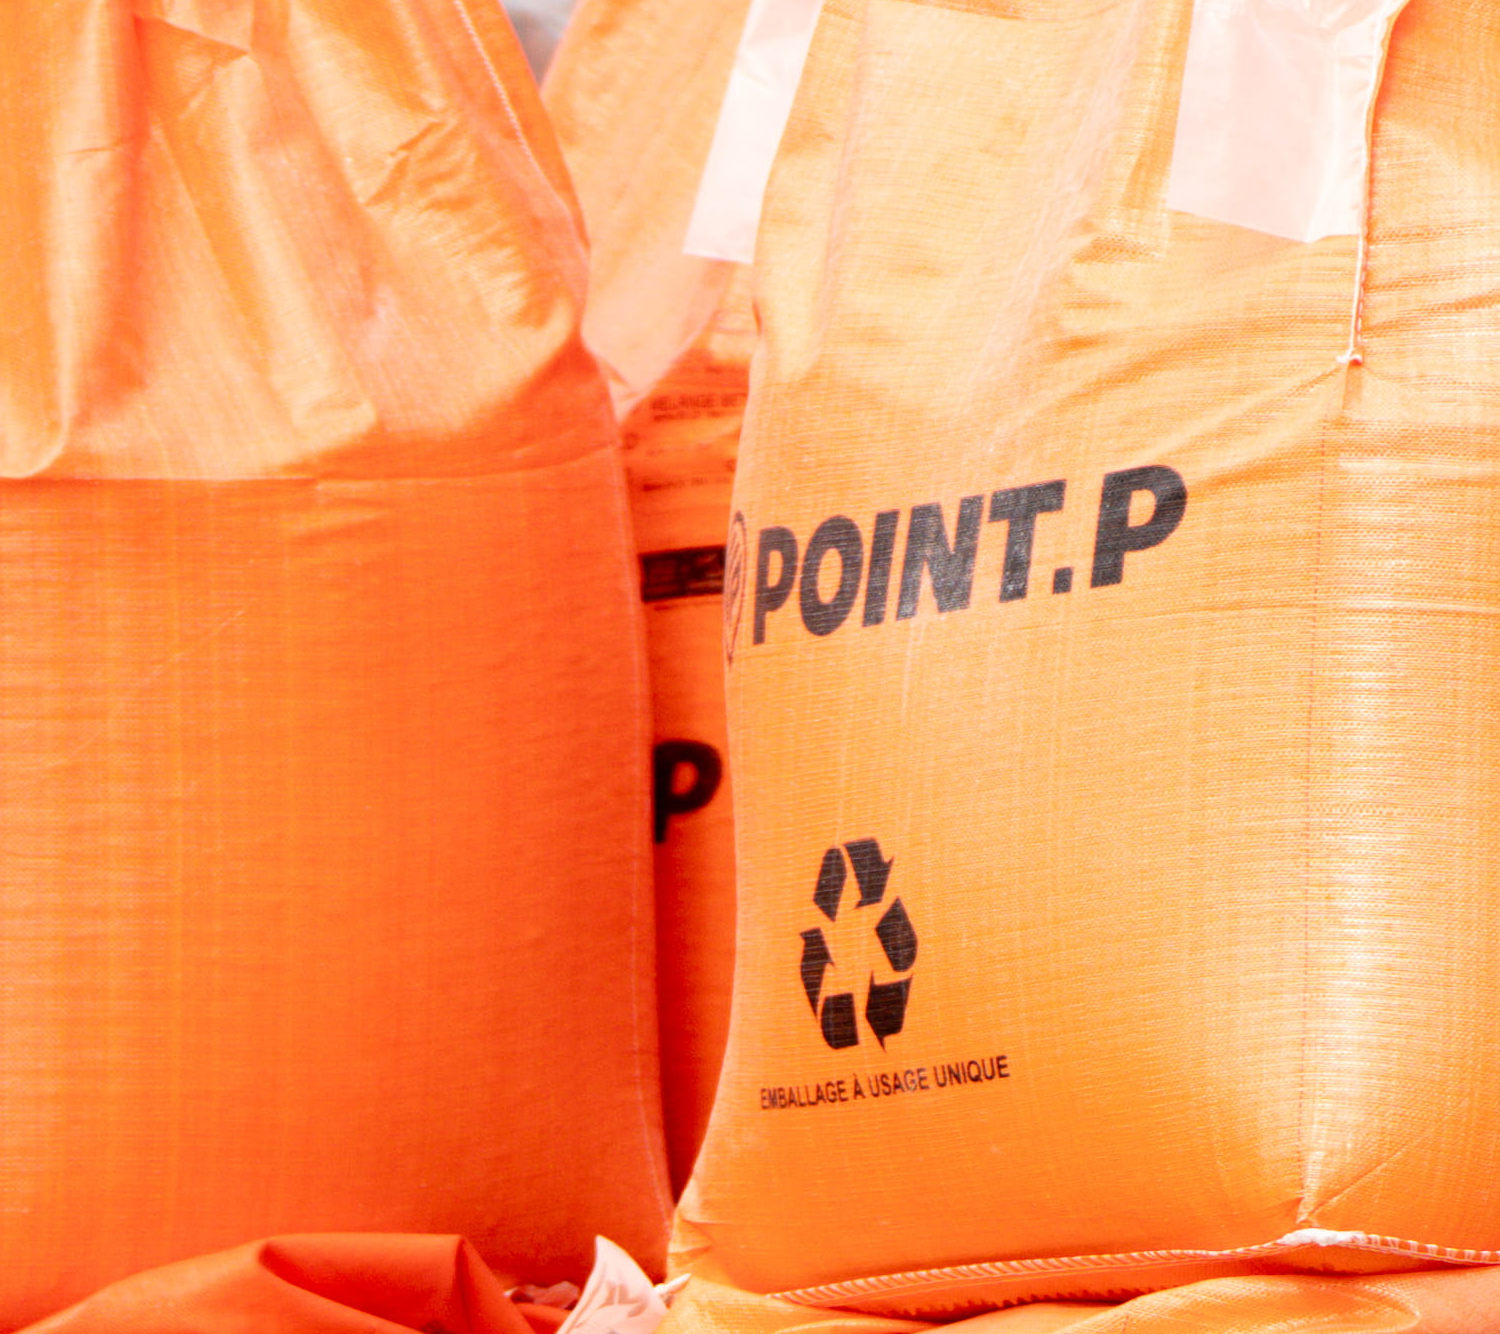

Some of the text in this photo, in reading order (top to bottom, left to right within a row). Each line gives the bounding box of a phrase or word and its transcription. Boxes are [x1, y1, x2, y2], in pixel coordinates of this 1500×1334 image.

[753, 464, 1189, 645] POINT.P
[760, 1053, 1011, 1111] EMBALLAGE À USAGE UNIQUE
